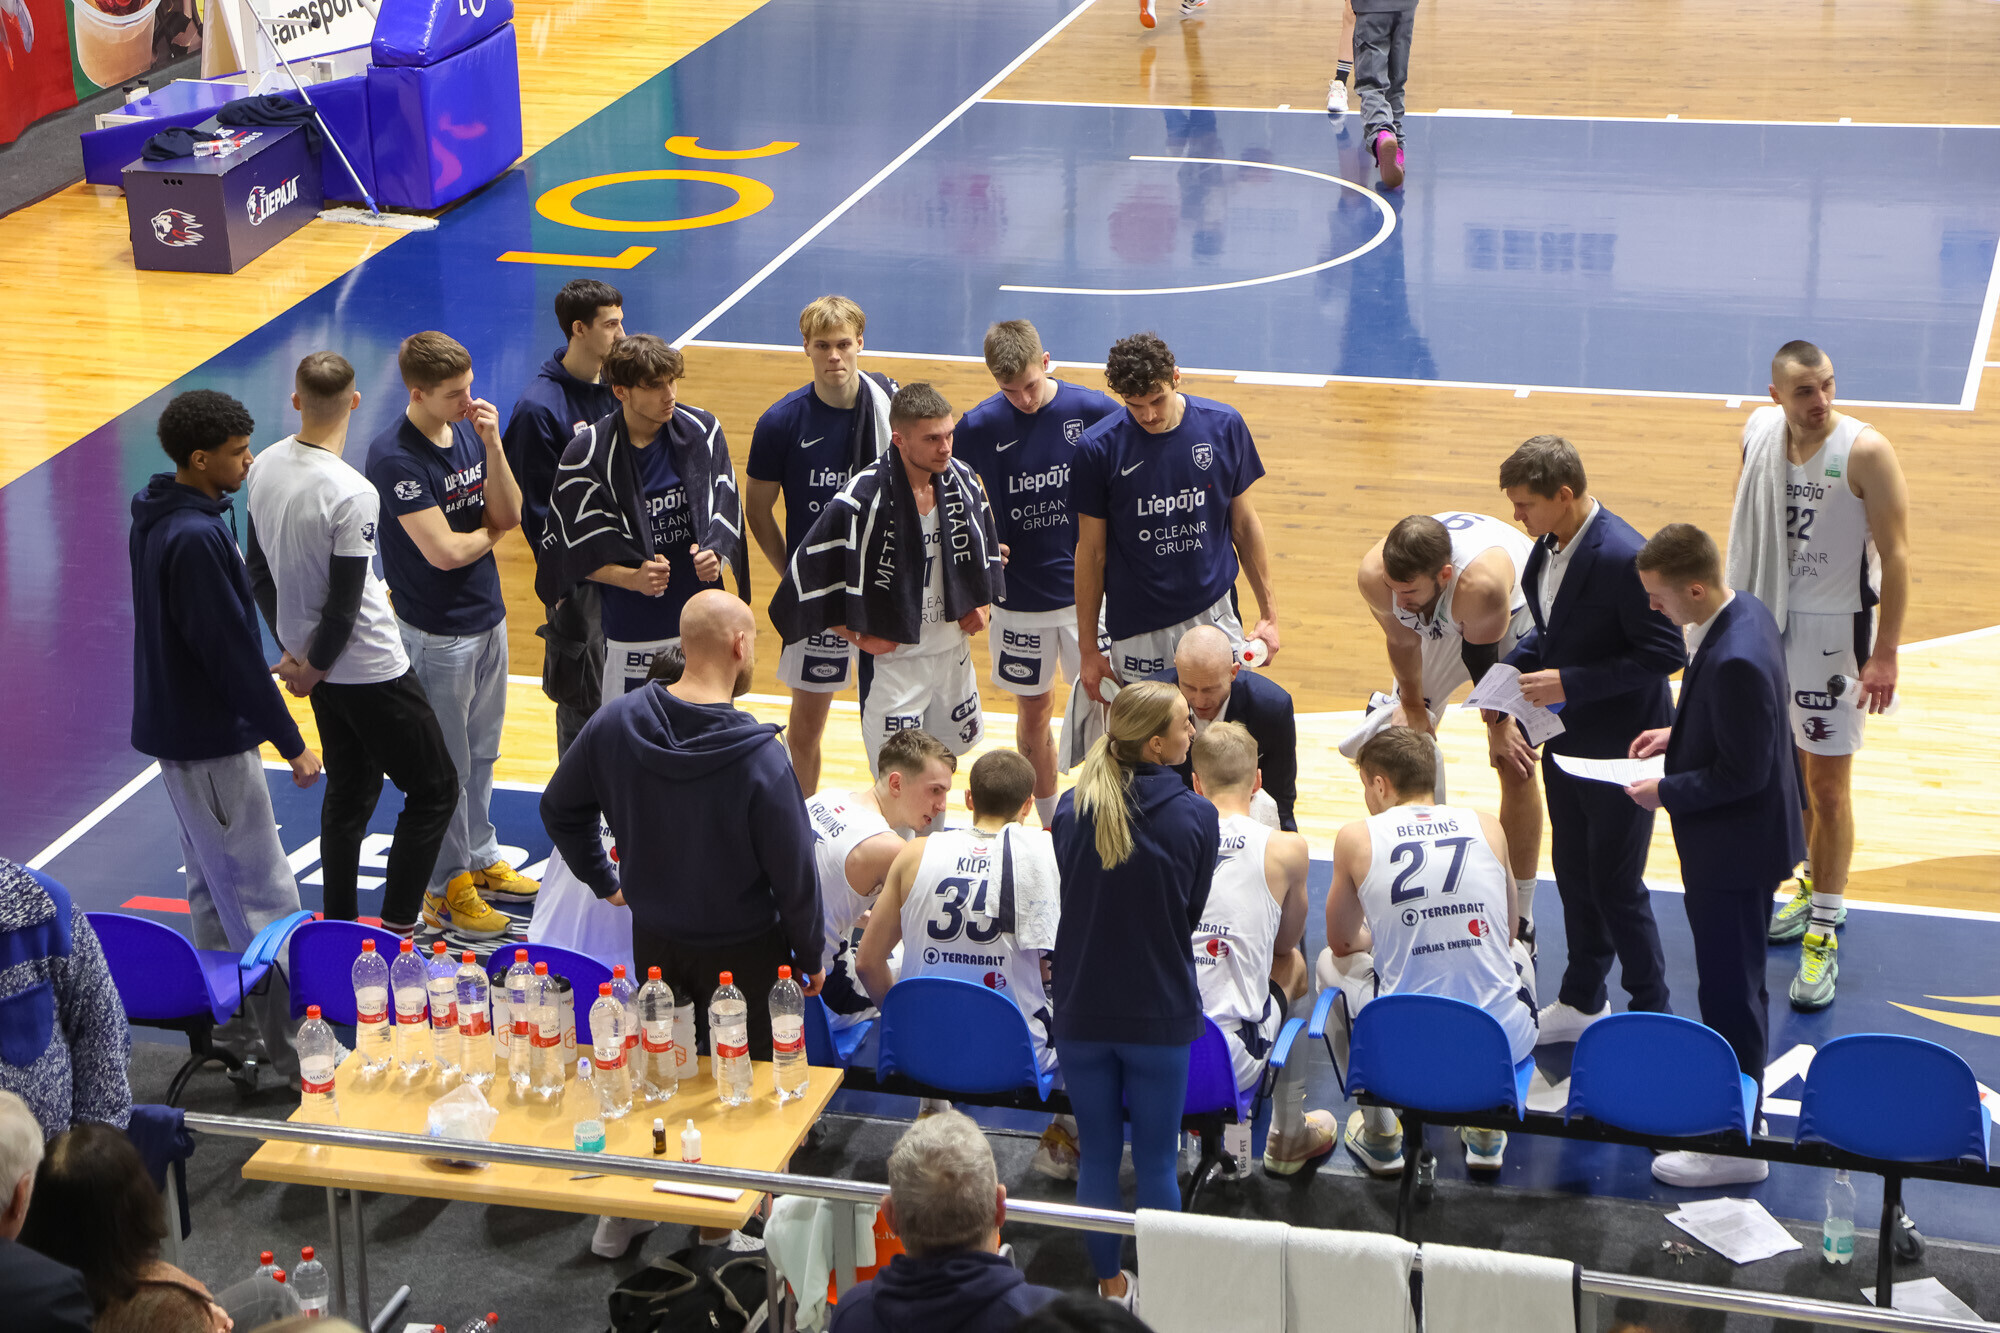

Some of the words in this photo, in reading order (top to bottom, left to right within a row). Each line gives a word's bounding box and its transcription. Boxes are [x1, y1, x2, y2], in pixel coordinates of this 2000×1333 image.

[1023, 499, 1068, 518] CLEAN
[1137, 486, 1205, 517] Liepāja
[1023, 513, 1070, 531] GRUPA
[1154, 521, 1207, 541] CLEANR
[1786, 506, 1818, 541] 22
[652, 529, 692, 546] RUPA
[1155, 538, 1203, 556] GRUPA
[807, 633, 850, 649] BCS
[1003, 629, 1041, 649] BCS
[626, 651, 655, 667] BC
[1124, 655, 1164, 673] BCS
[1390, 836, 1479, 907] 27
[1420, 903, 1485, 920] TERRABALT
[942, 952, 1005, 967] TERRABALT
